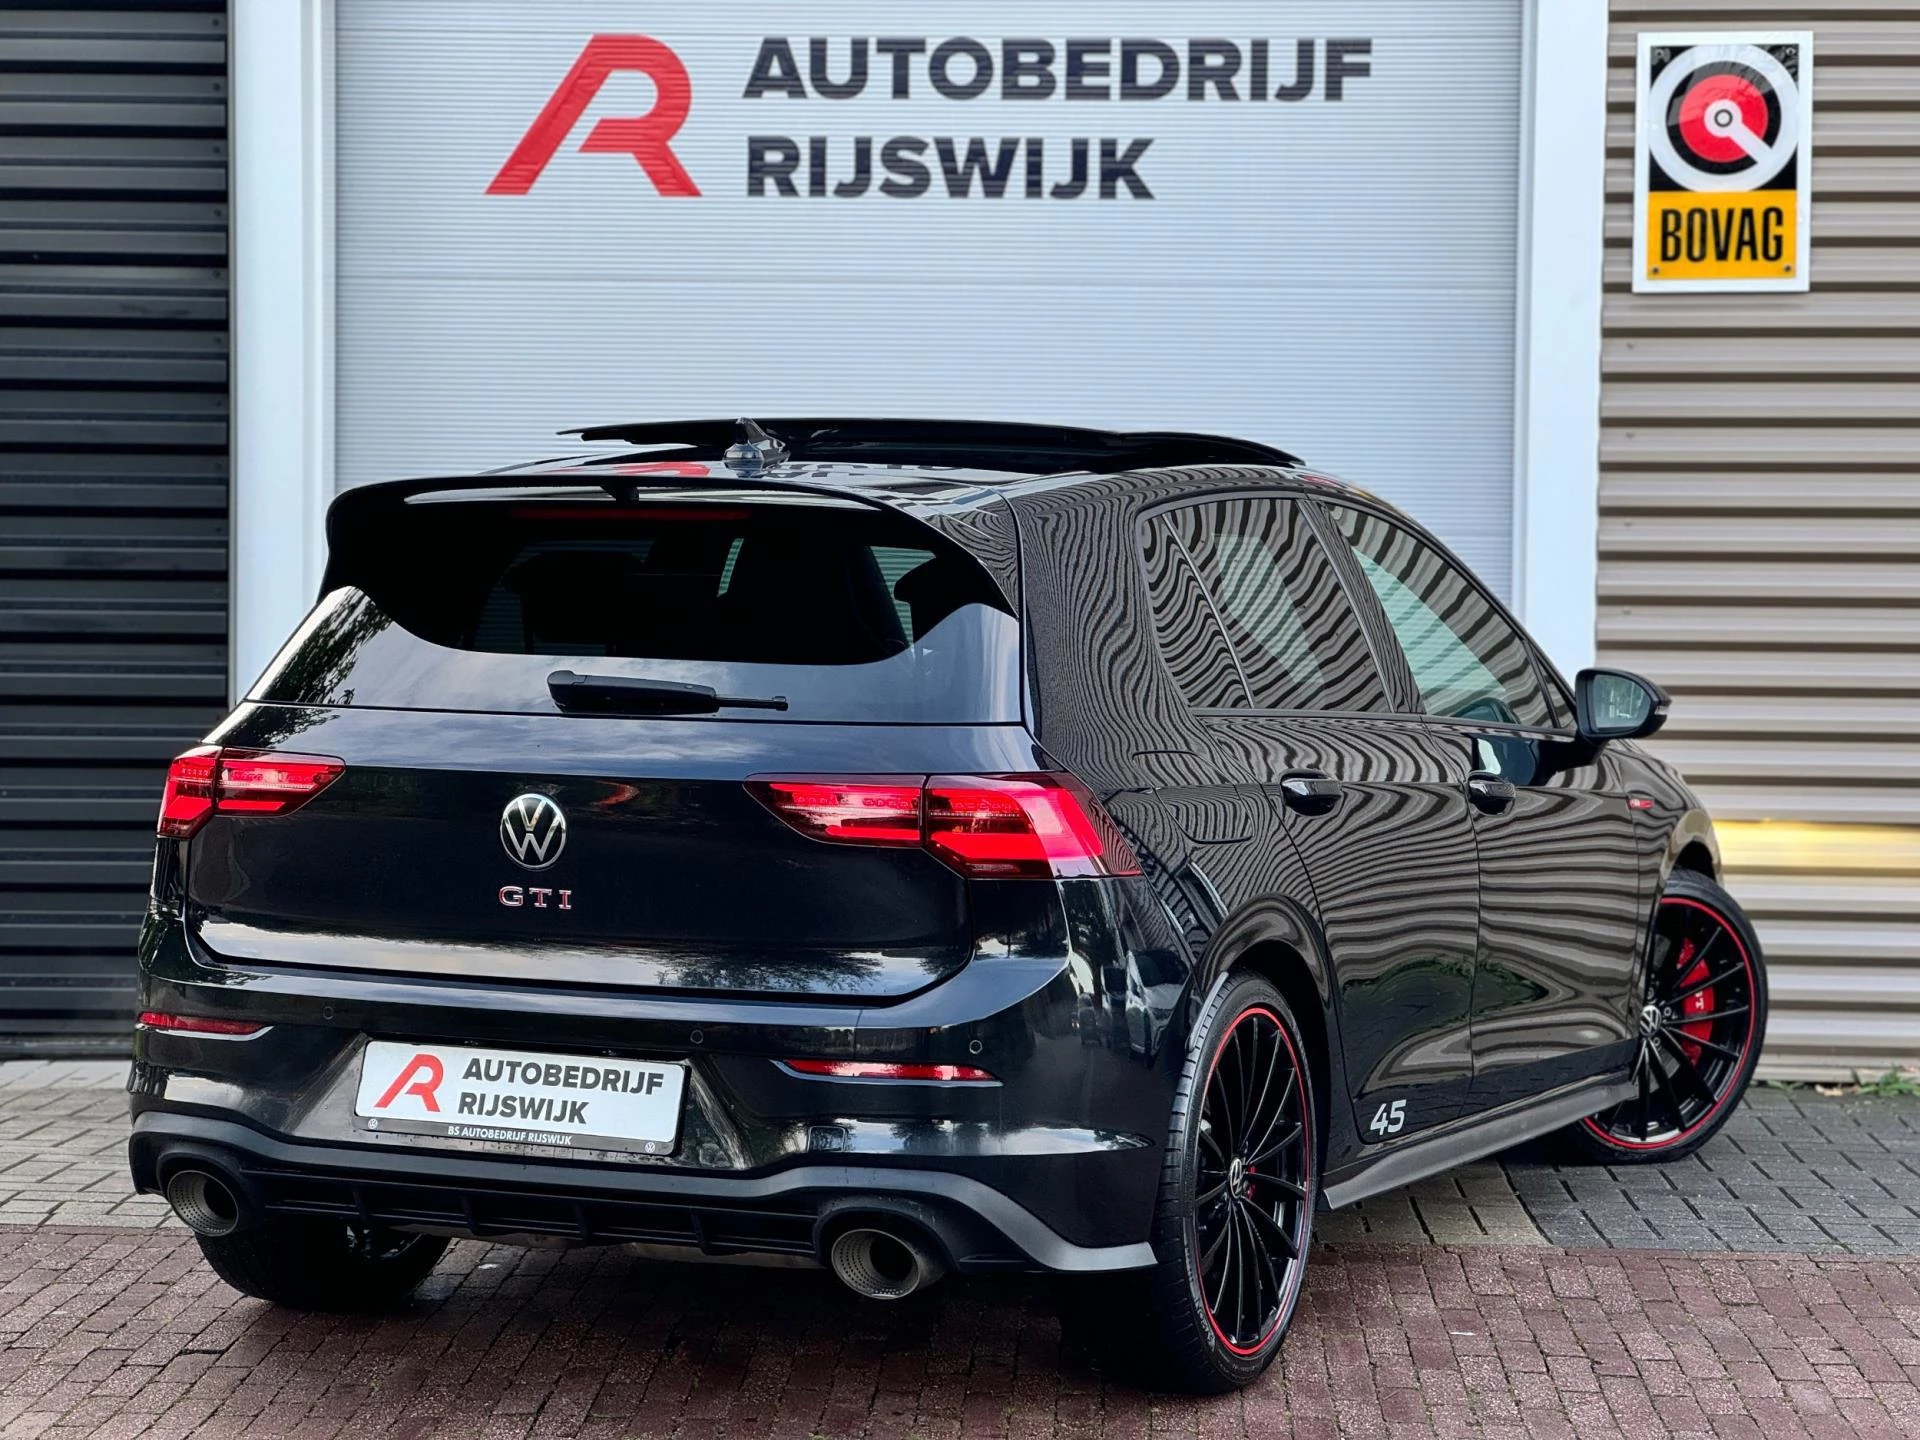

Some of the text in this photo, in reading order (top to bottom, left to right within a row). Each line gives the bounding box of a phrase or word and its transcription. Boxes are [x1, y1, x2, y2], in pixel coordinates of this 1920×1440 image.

[743, 37, 1373, 102] AUTOBEDRIJF
[747, 136, 1155, 200] RIJSWIJK
[1661, 207, 1784, 262] BOVAG
[499, 885, 573, 910] GTI
[462, 1057, 665, 1095] AUTOBEDRIJF
[457, 1092, 590, 1124] RIJSWIJK
[1370, 1099, 1407, 1136] 45
[447, 1126, 572, 1145] BS AUTOBEDRIJF RIJSWIJK
